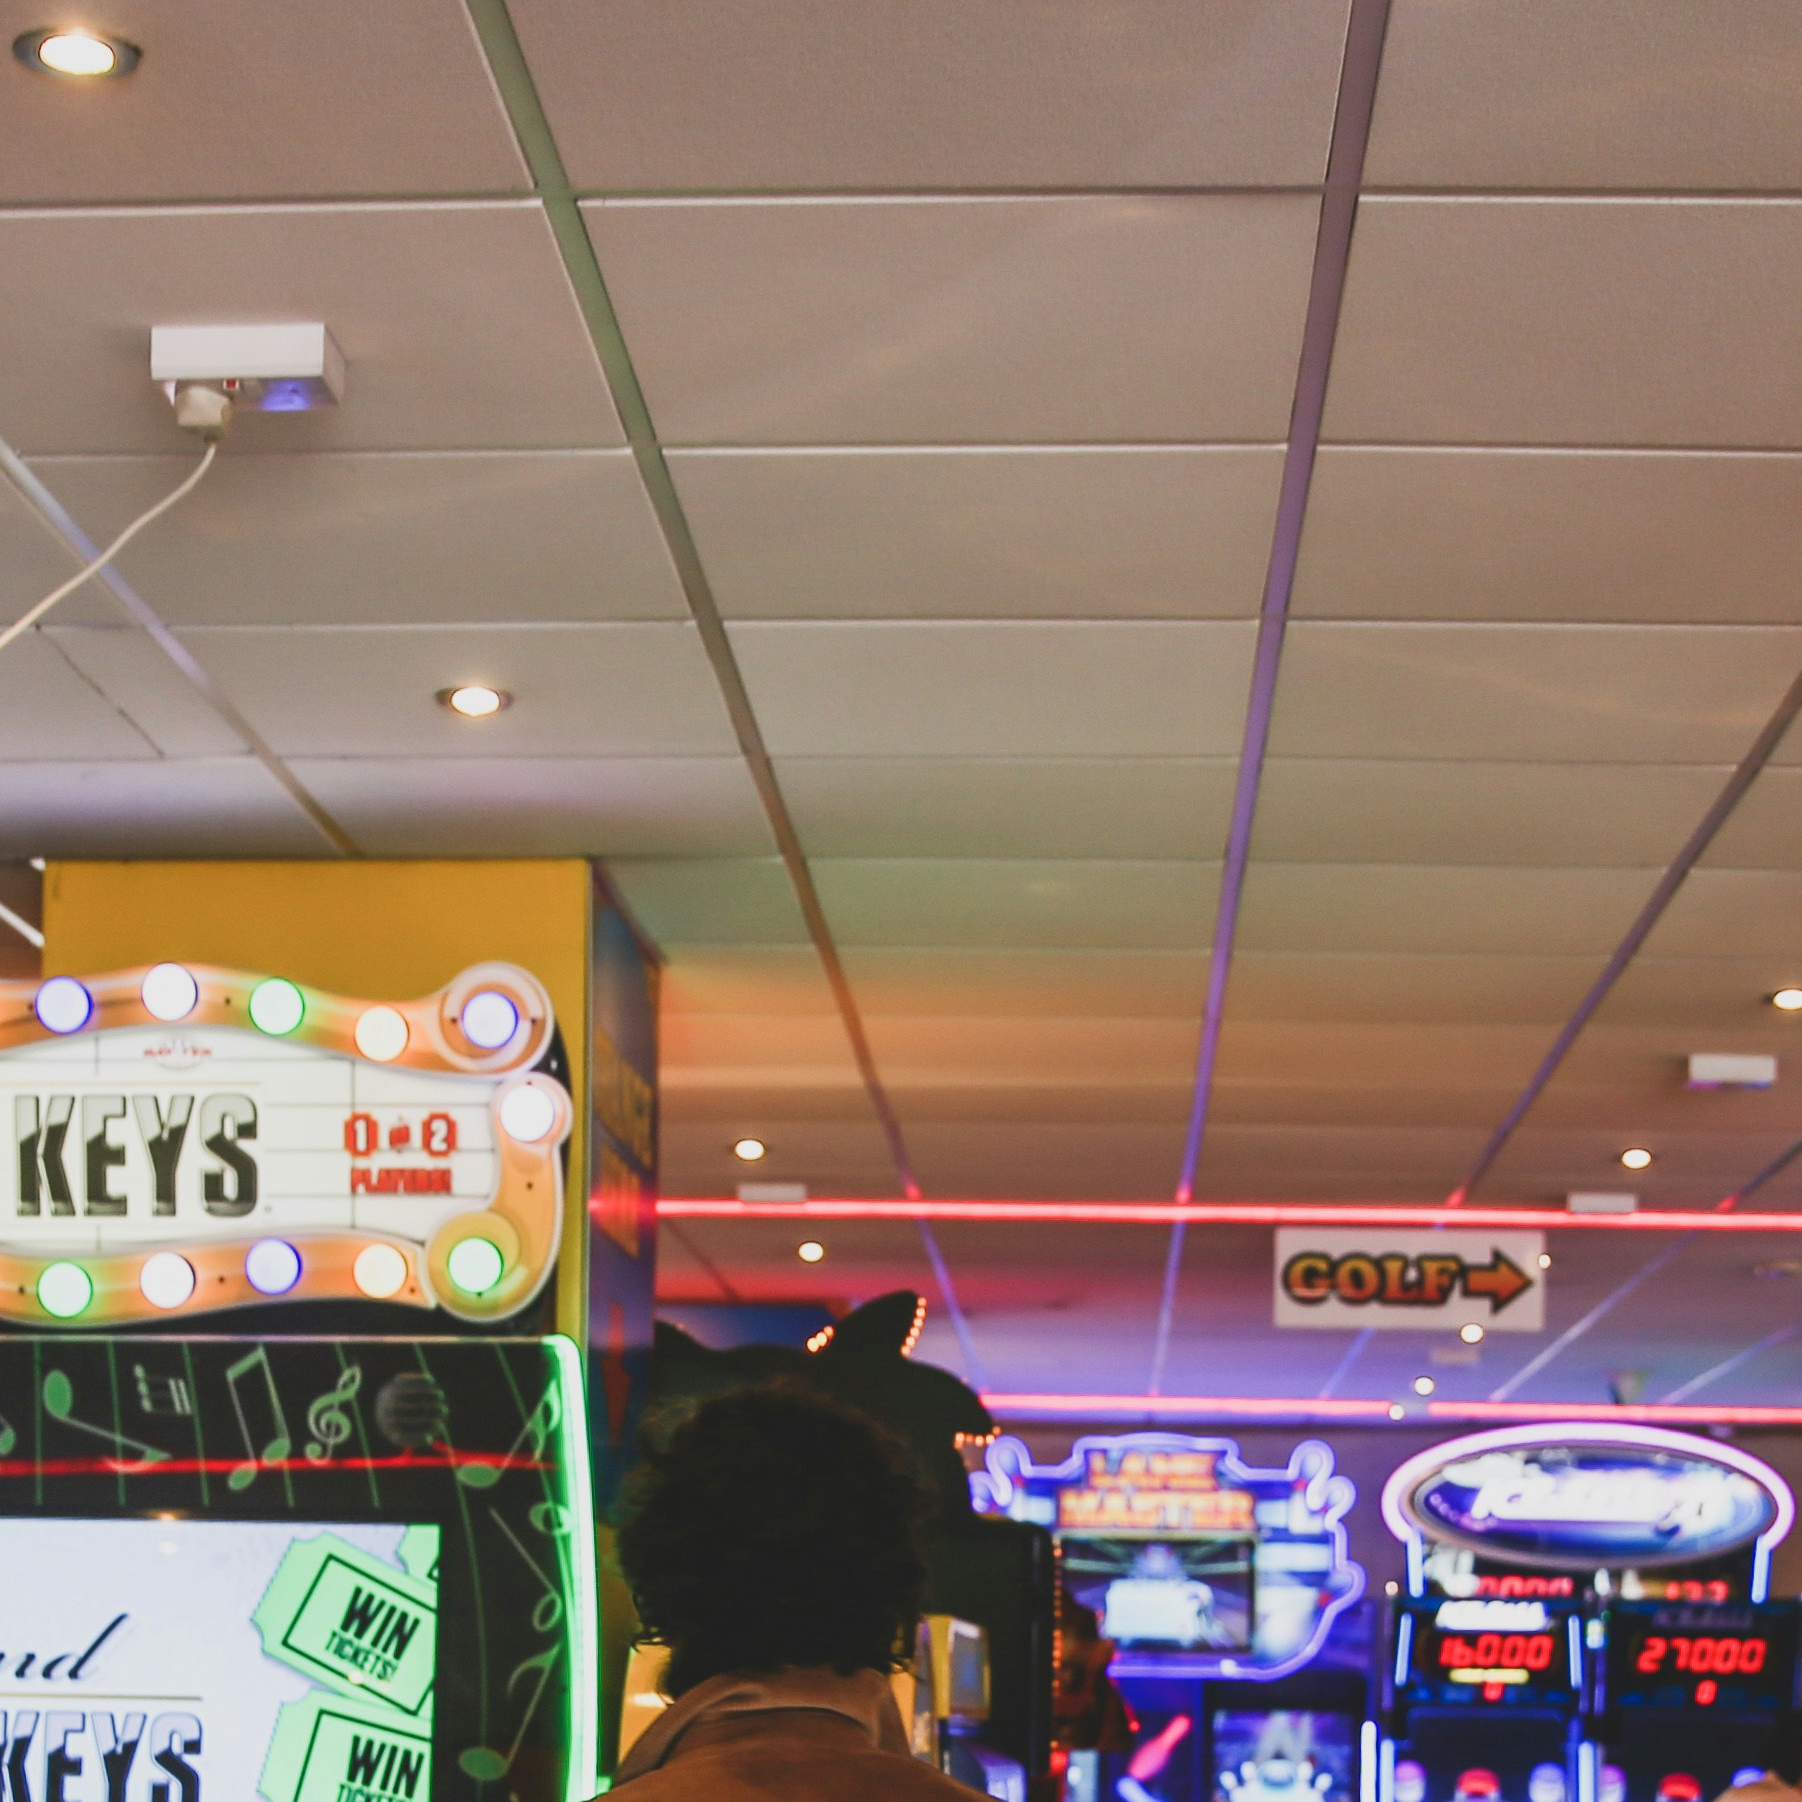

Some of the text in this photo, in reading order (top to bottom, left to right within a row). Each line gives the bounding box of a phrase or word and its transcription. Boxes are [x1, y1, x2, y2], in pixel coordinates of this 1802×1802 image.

[13, 1093, 259, 1218] KEYS
[1283, 1251, 1465, 1307] GOLF
[324, 1629, 399, 1682] TICKETS!
[339, 1584, 421, 1661] WIN
[345, 1734, 426, 1800] WIN
